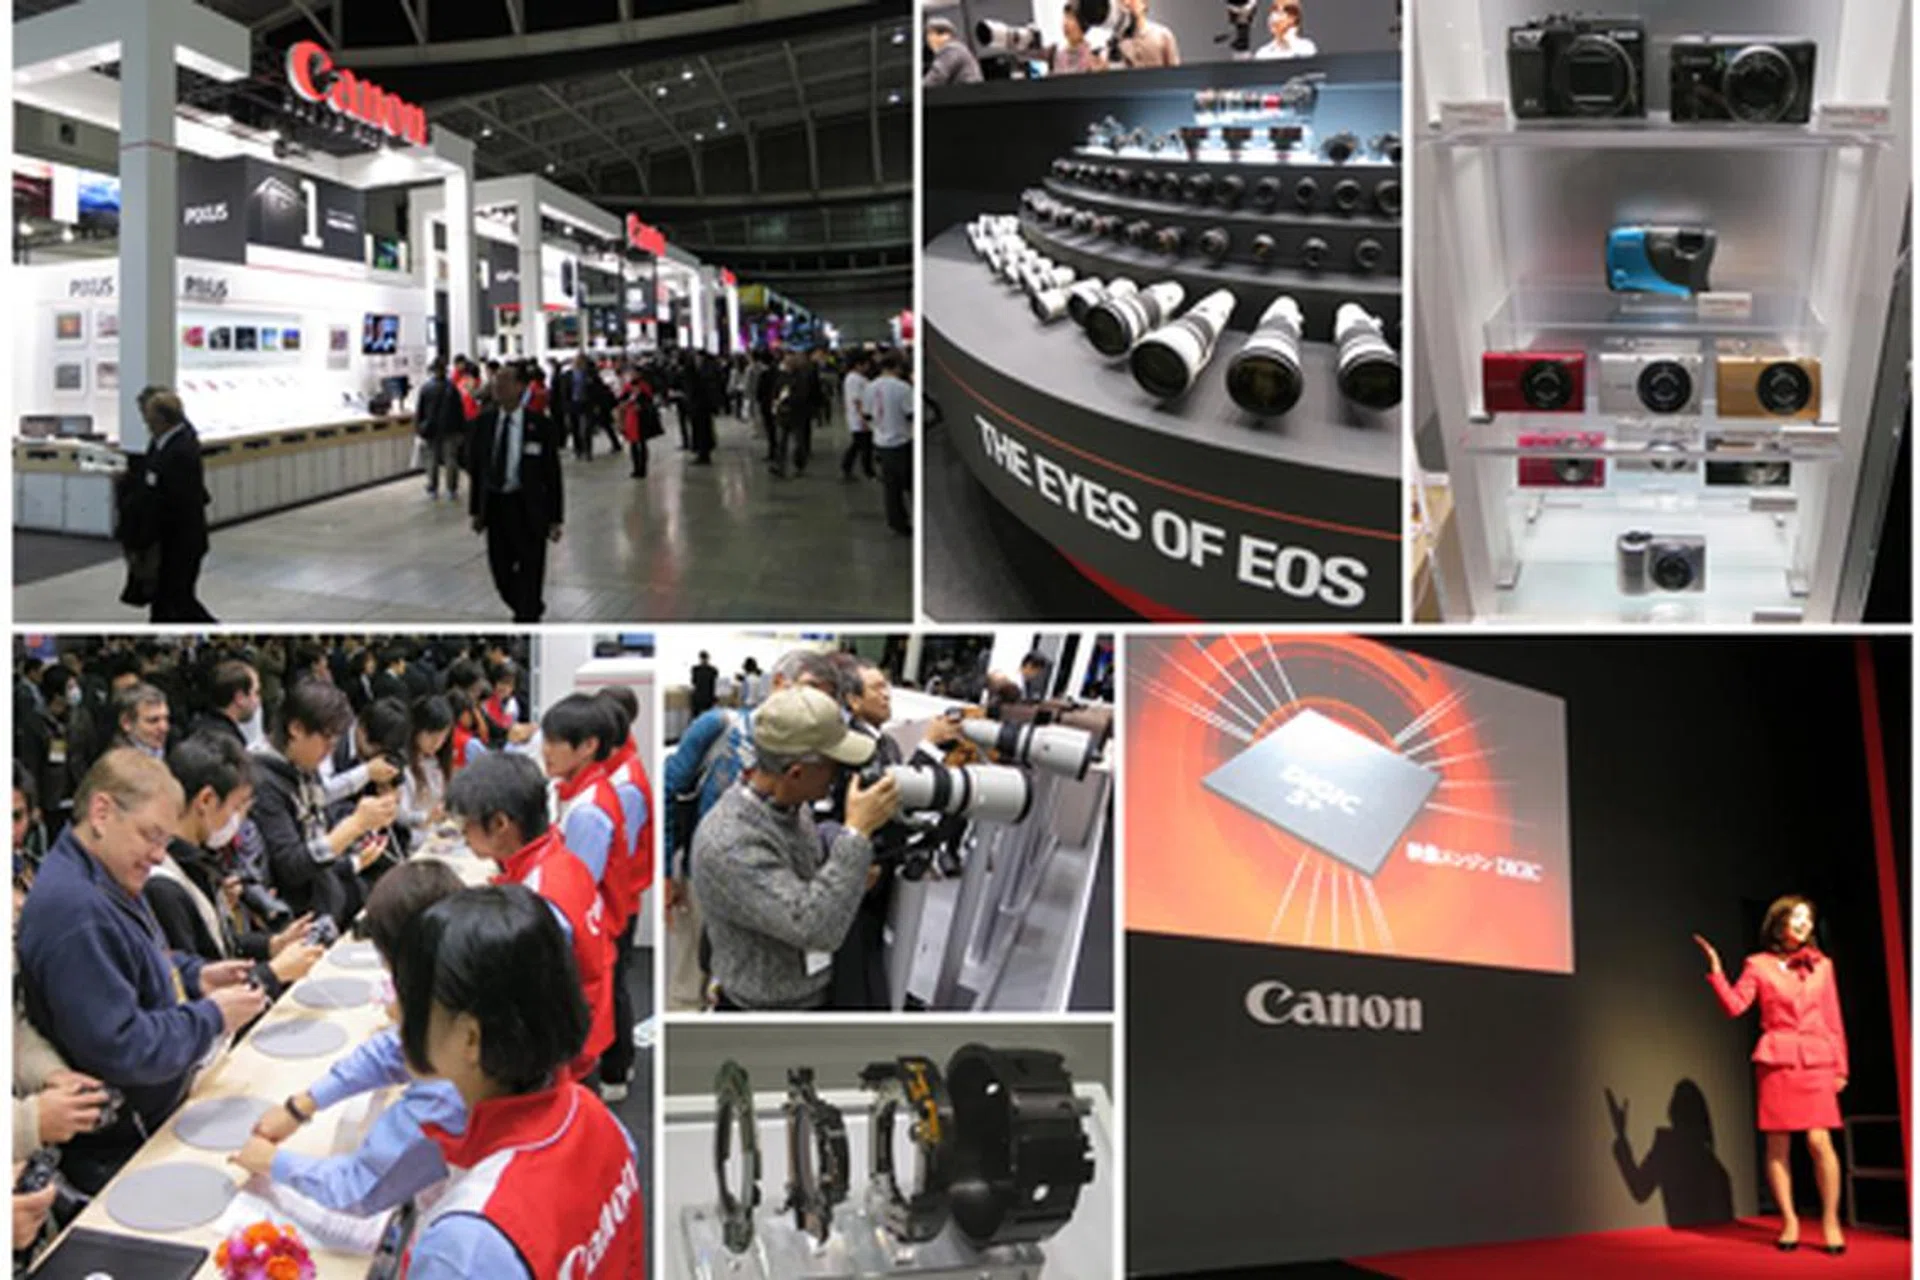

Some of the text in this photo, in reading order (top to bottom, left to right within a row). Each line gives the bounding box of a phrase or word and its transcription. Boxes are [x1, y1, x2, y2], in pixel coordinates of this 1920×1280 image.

[286, 39, 427, 147] Canon
[974, 413, 1369, 608] THE EYES OF EOS
[1245, 980, 1423, 1031] Canon
[557, 1158, 640, 1280] Canon
